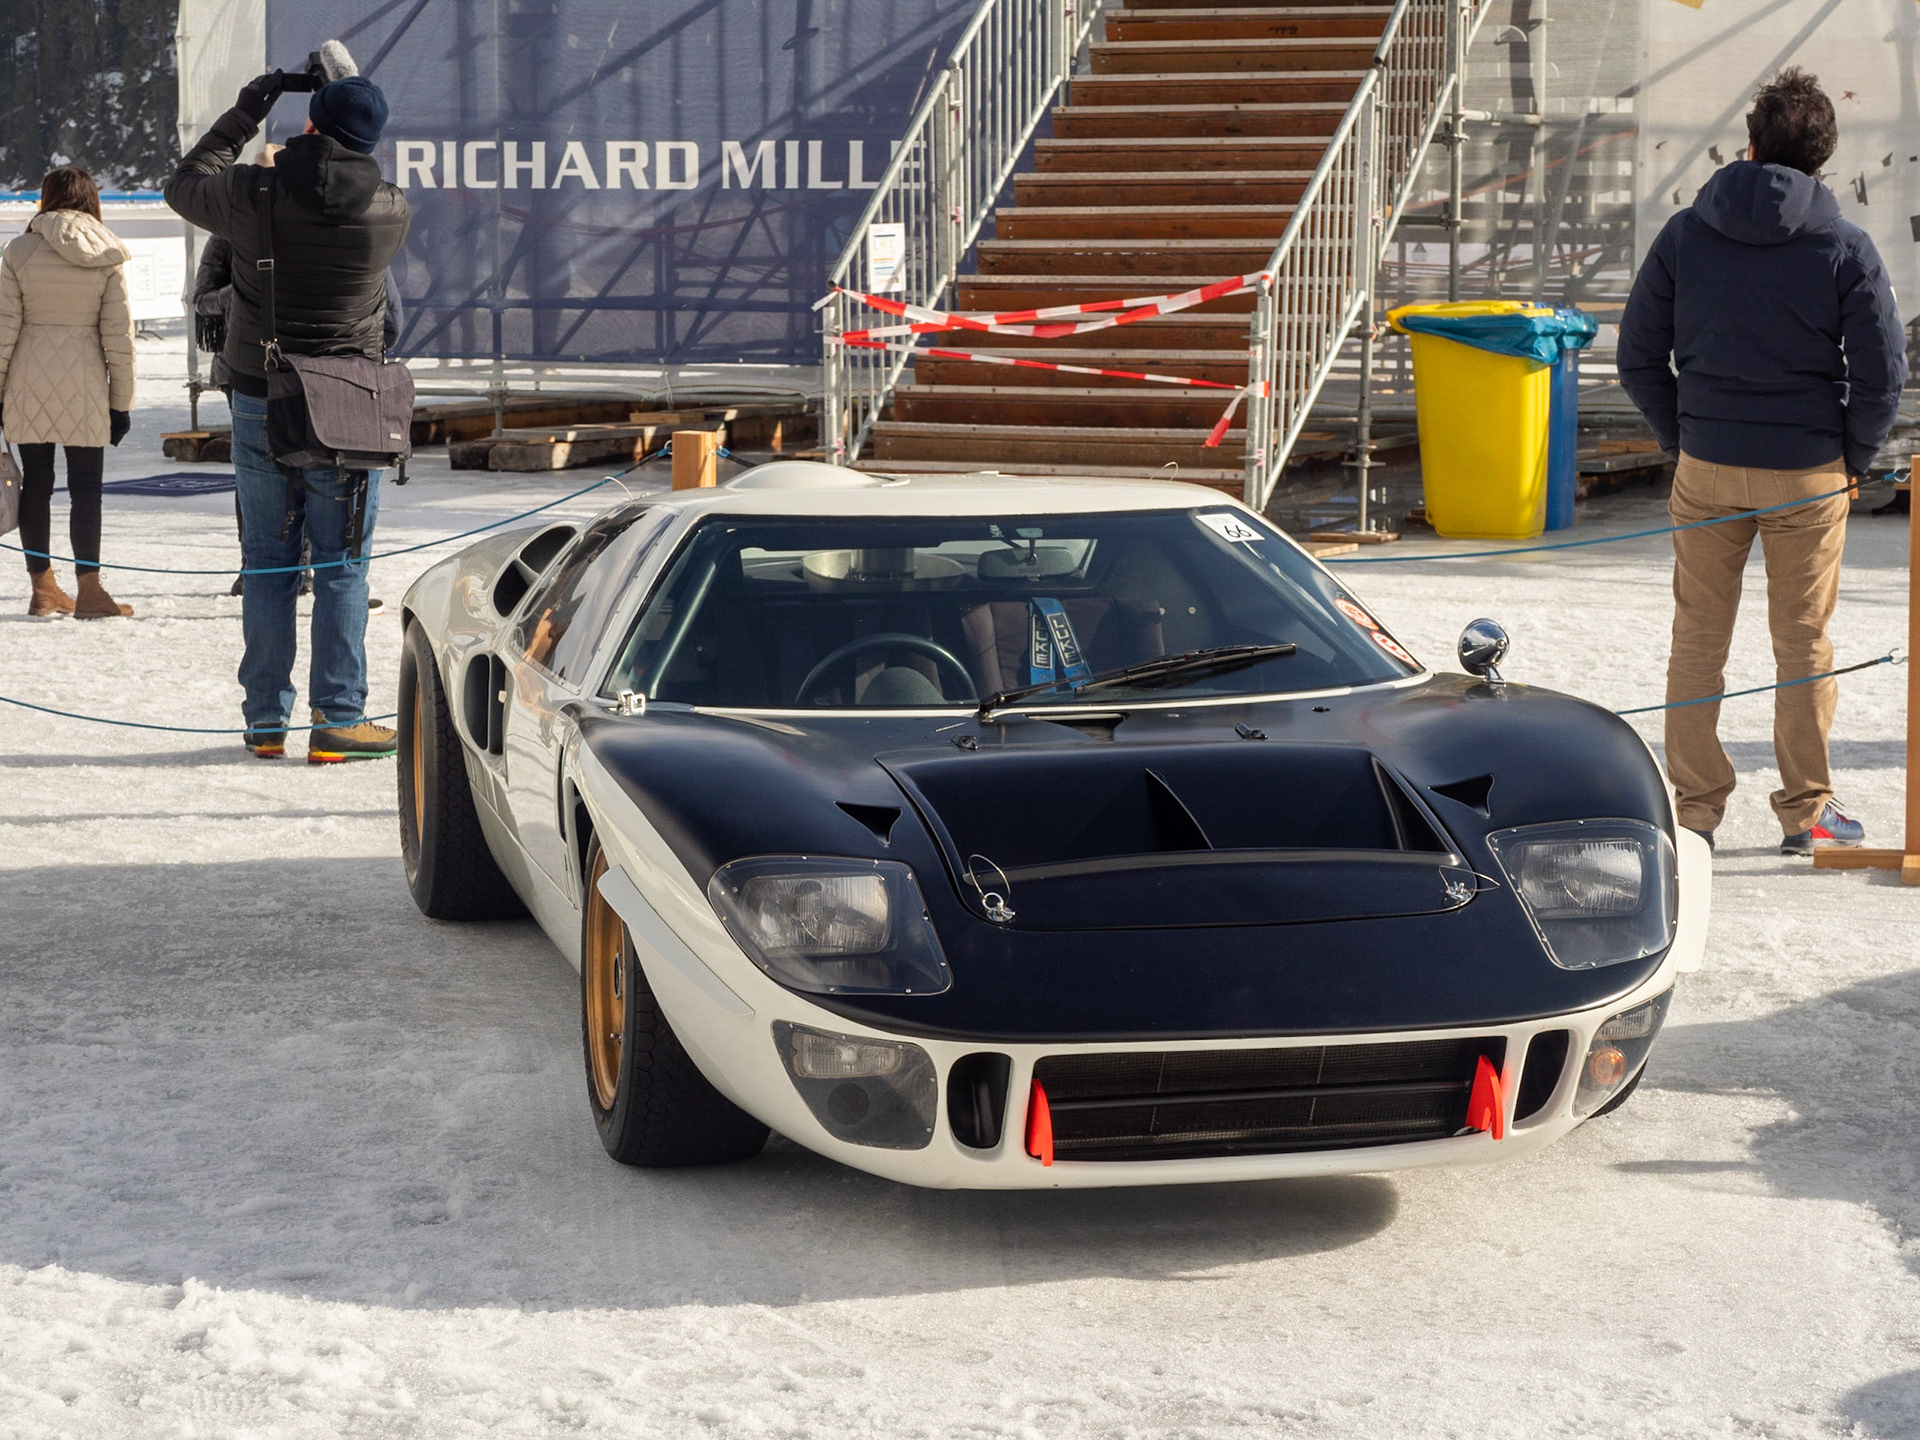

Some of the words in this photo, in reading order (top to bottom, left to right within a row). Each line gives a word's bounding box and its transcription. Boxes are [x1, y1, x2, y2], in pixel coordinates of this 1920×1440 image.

[395, 140, 699, 190] RICHARD
[1224, 524, 1252, 538] 66
[1052, 619, 1076, 662] LUKE
